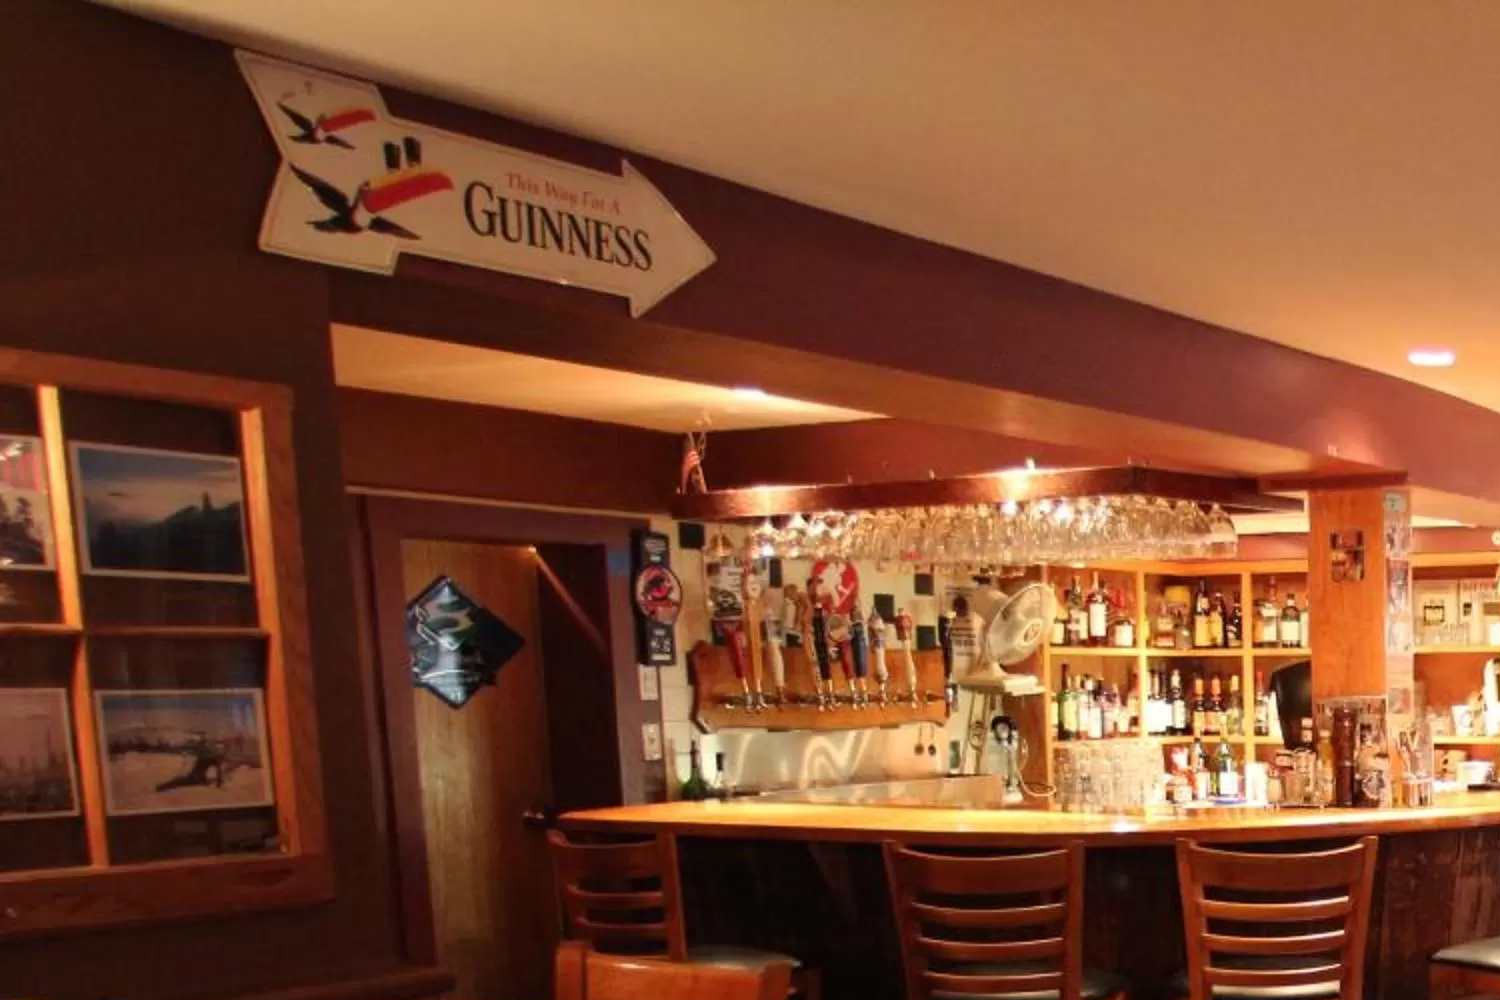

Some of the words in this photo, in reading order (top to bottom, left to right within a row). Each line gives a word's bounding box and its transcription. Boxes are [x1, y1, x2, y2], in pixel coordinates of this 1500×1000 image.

[463, 180, 653, 272] GUINNESS
[505, 171, 540, 195] This
[545, 179, 577, 210] Way
[583, 190, 605, 210] For
[610, 195, 621, 216] A
